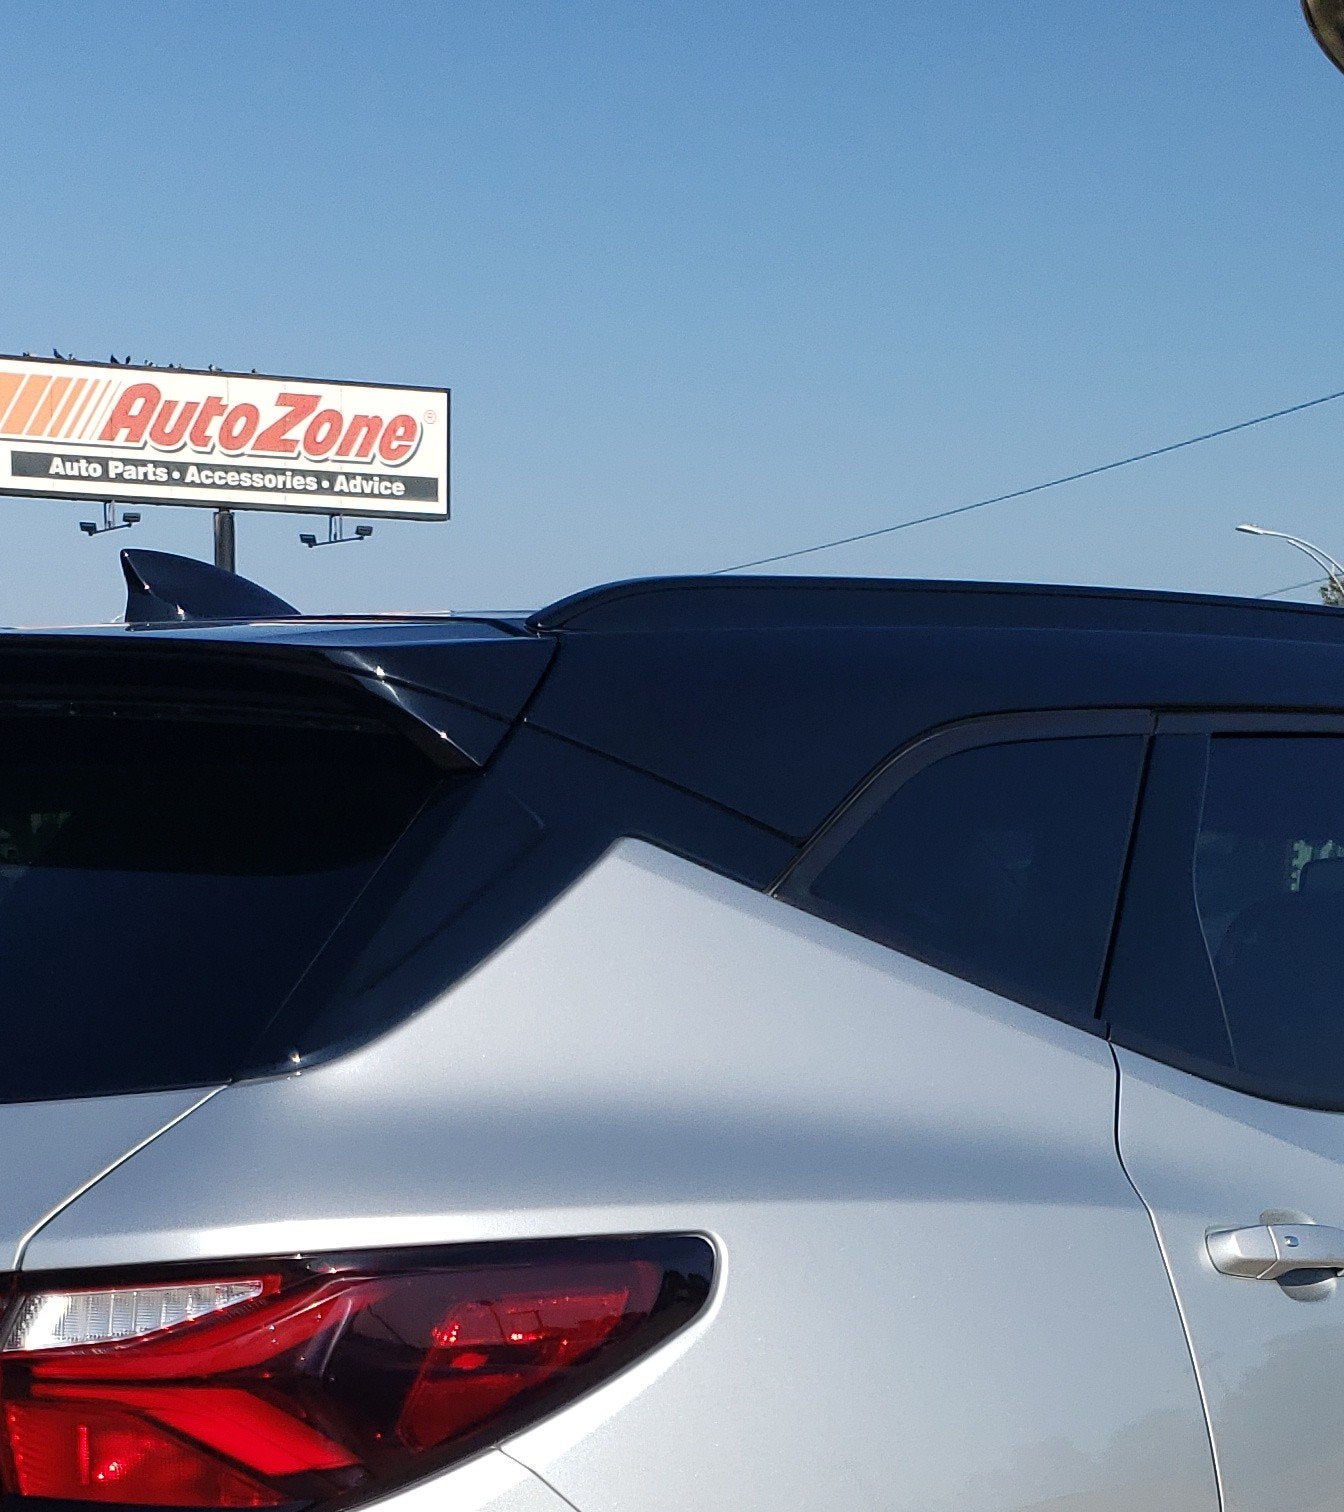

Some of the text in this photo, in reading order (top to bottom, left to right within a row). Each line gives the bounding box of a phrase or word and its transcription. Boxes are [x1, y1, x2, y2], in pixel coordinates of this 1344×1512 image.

[97, 382, 419, 461] AutoZone
[49, 456, 406, 496] Auto Parts Accessories Advice
